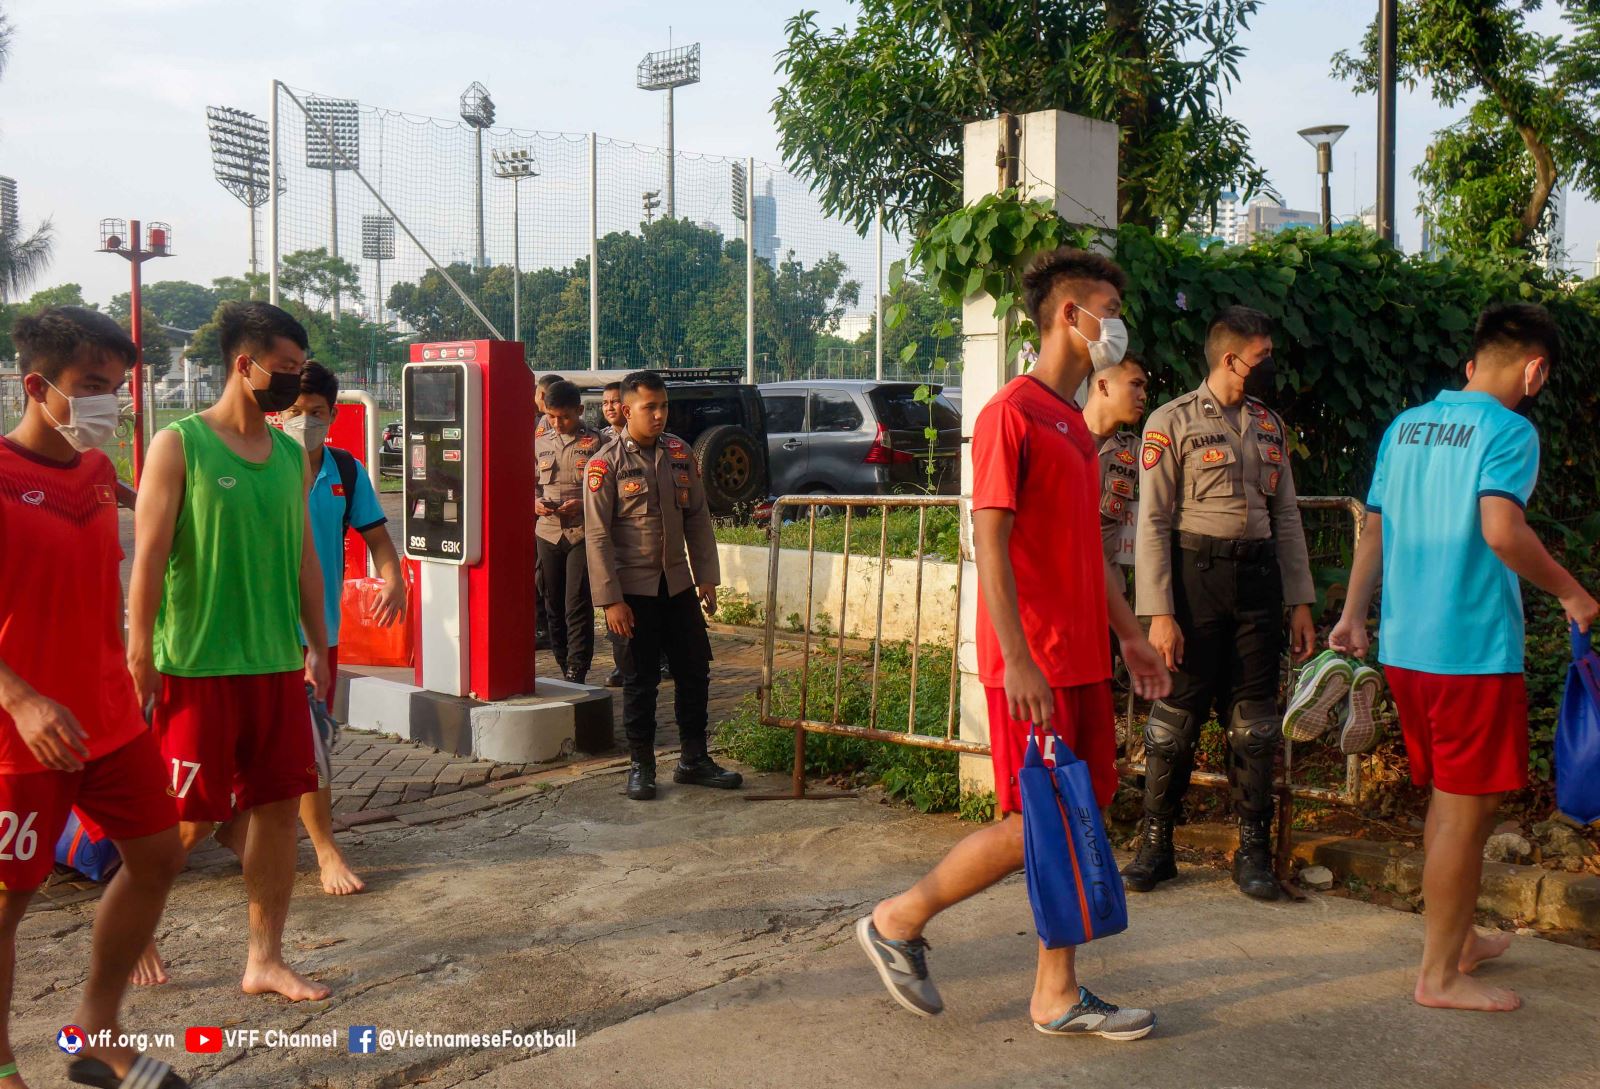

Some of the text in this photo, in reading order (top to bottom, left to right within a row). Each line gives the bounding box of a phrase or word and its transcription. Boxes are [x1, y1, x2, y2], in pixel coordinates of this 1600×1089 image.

[1190, 433, 1227, 449] ILHAM
[1397, 421, 1476, 449] VIETNAM
[1108, 463, 1137, 479] POLRI
[441, 540, 460, 554] GBK
[171, 758, 201, 799] 17
[0, 811, 39, 861] 26
